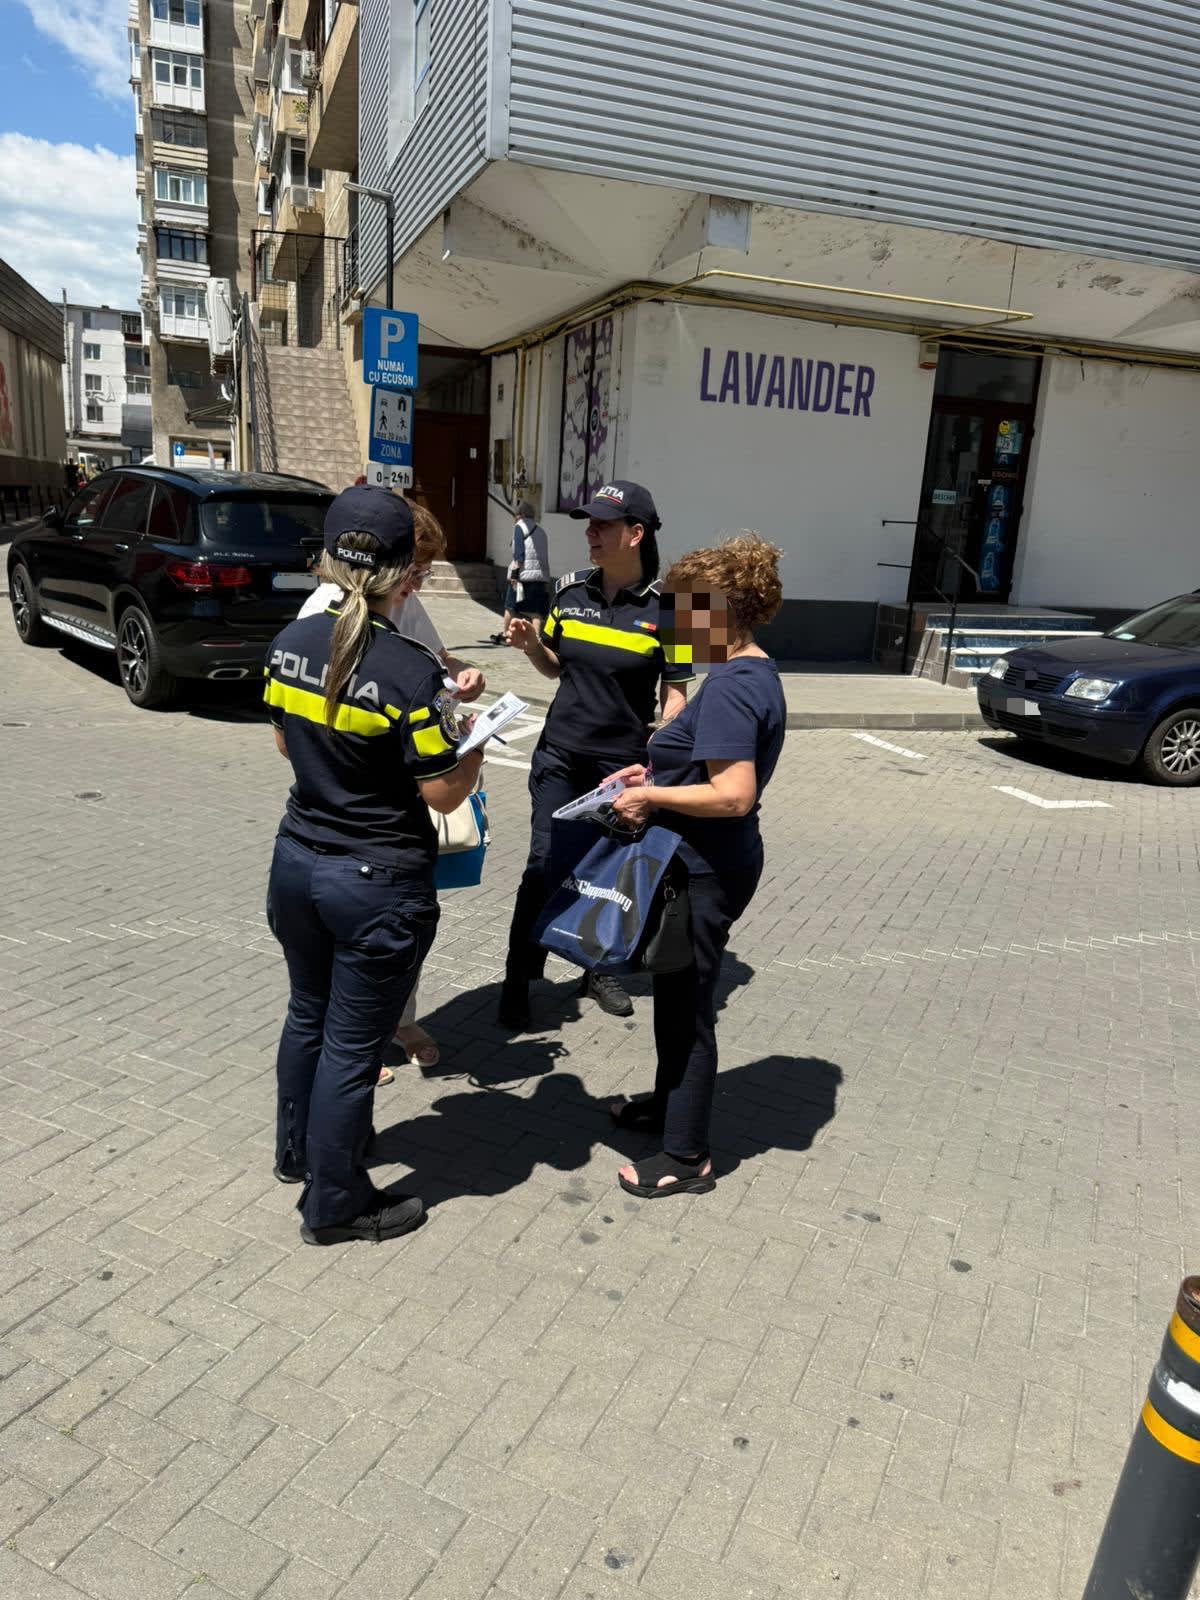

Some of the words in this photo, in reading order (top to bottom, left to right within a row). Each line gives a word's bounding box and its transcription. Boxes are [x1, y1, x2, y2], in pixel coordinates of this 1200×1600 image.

[380, 315, 405, 359] P
[377, 359, 405, 372] NUMAI
[368, 371, 381, 383] CU
[382, 372, 414, 386] ECUSON
[700, 347, 875, 417] LAVANDER
[380, 444, 402, 459] ZONA
[337, 547, 373, 563] POLITIA
[562, 607, 601, 619] POLITIA
[271, 650, 380, 705] POLIIA
